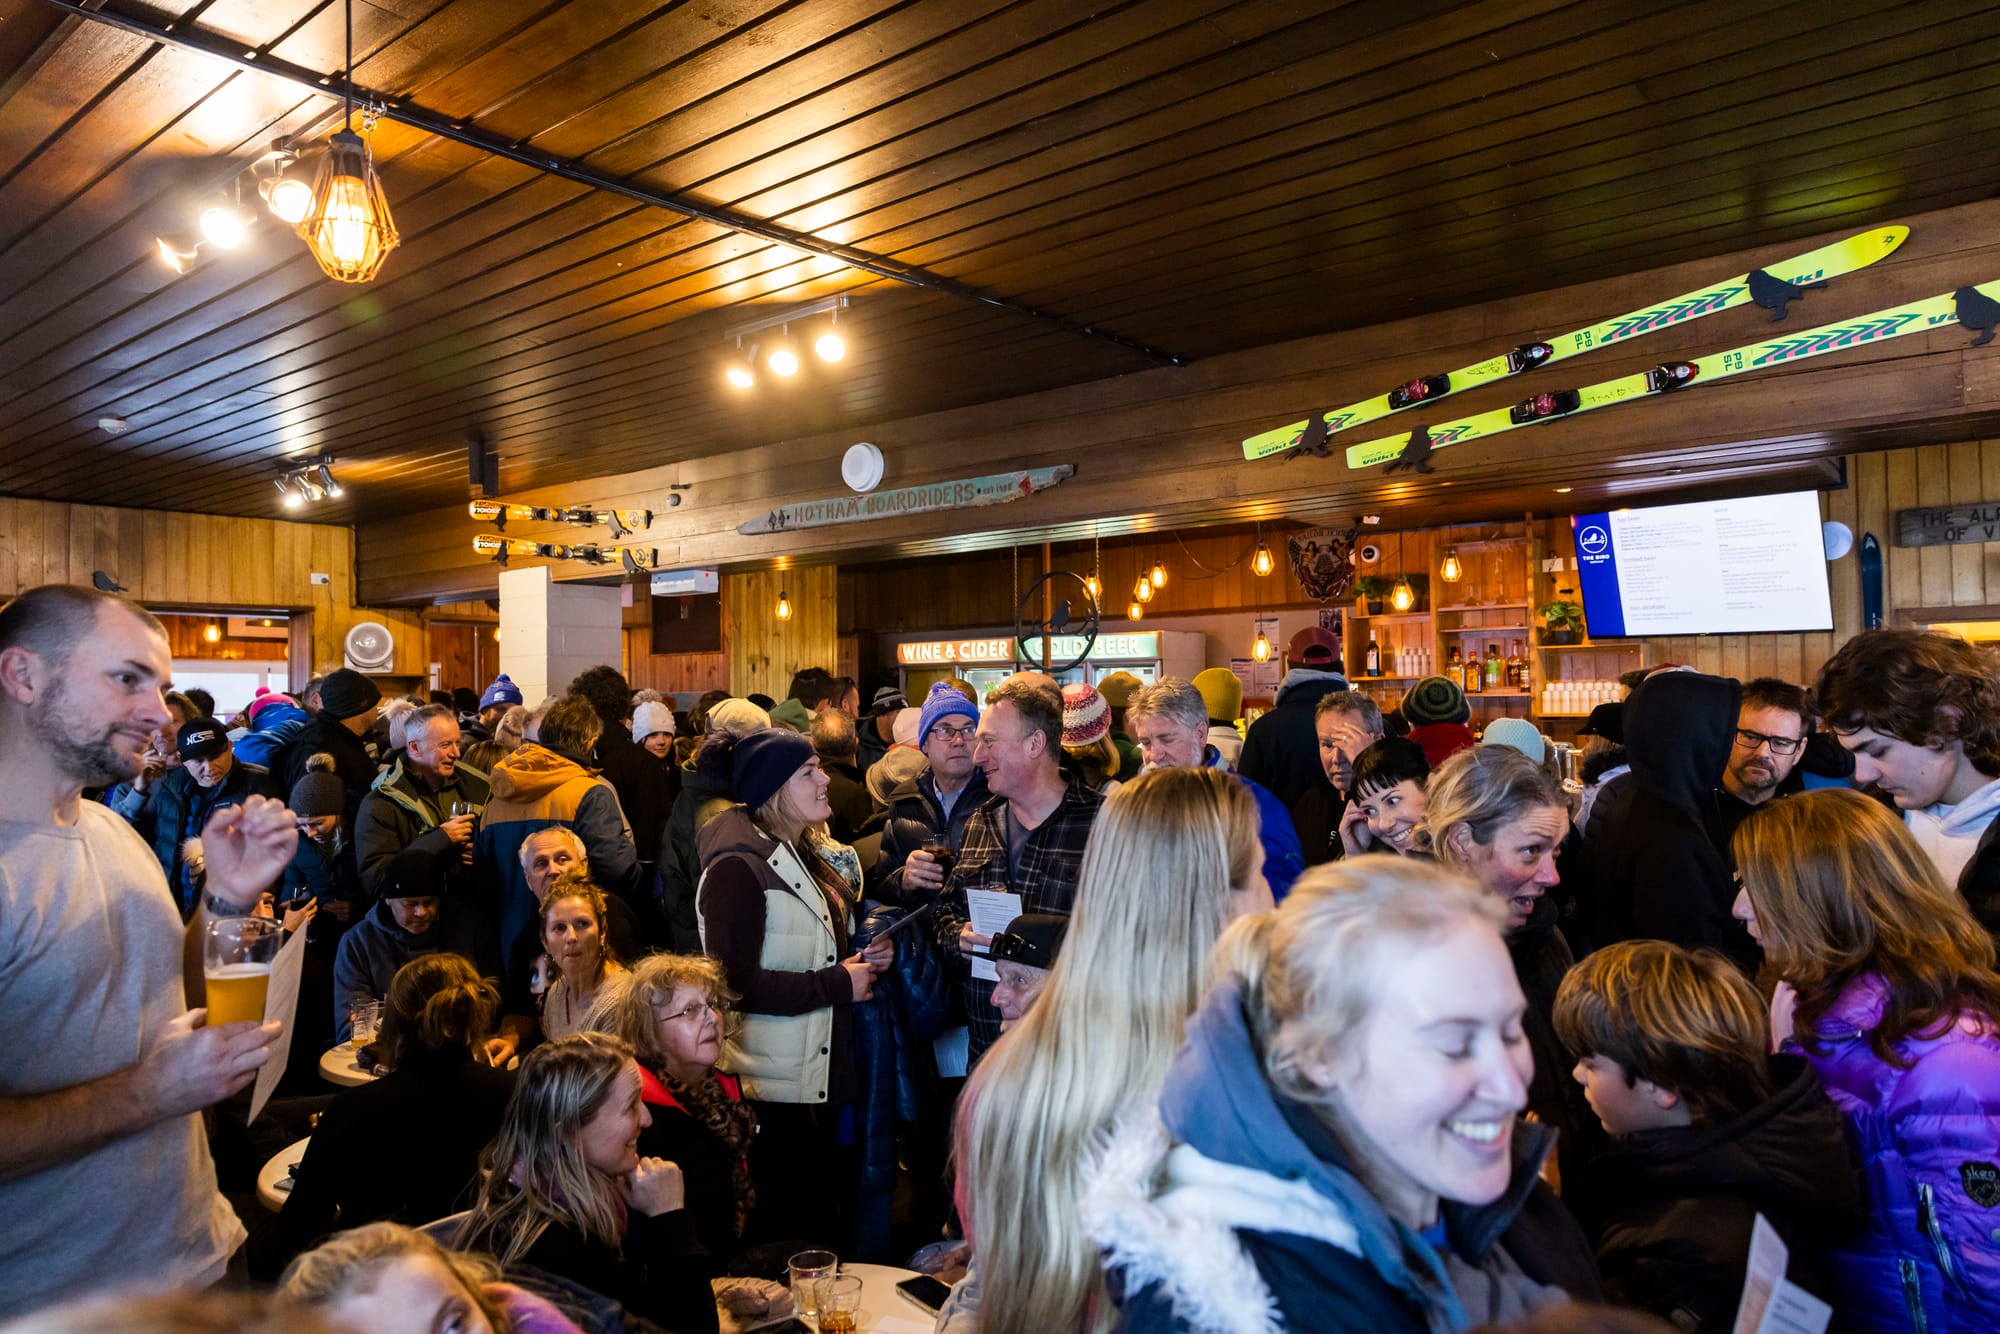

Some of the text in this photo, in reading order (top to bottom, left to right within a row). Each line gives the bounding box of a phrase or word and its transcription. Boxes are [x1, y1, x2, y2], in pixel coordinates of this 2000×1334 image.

[1574, 333, 1583, 350] SL
[1583, 330, 1593, 347] P9
[1723, 354, 1733, 372] SL
[1733, 352, 1743, 370] P9
[794, 499, 859, 522] HOTHAM
[867, 483, 975, 515] BOARDRIDERS
[1921, 511, 1954, 528] THE
[1944, 527, 1968, 541] OF
[902, 640, 1009, 661] WINE & CIDER
[1033, 636, 1139, 657] COLD BEER
